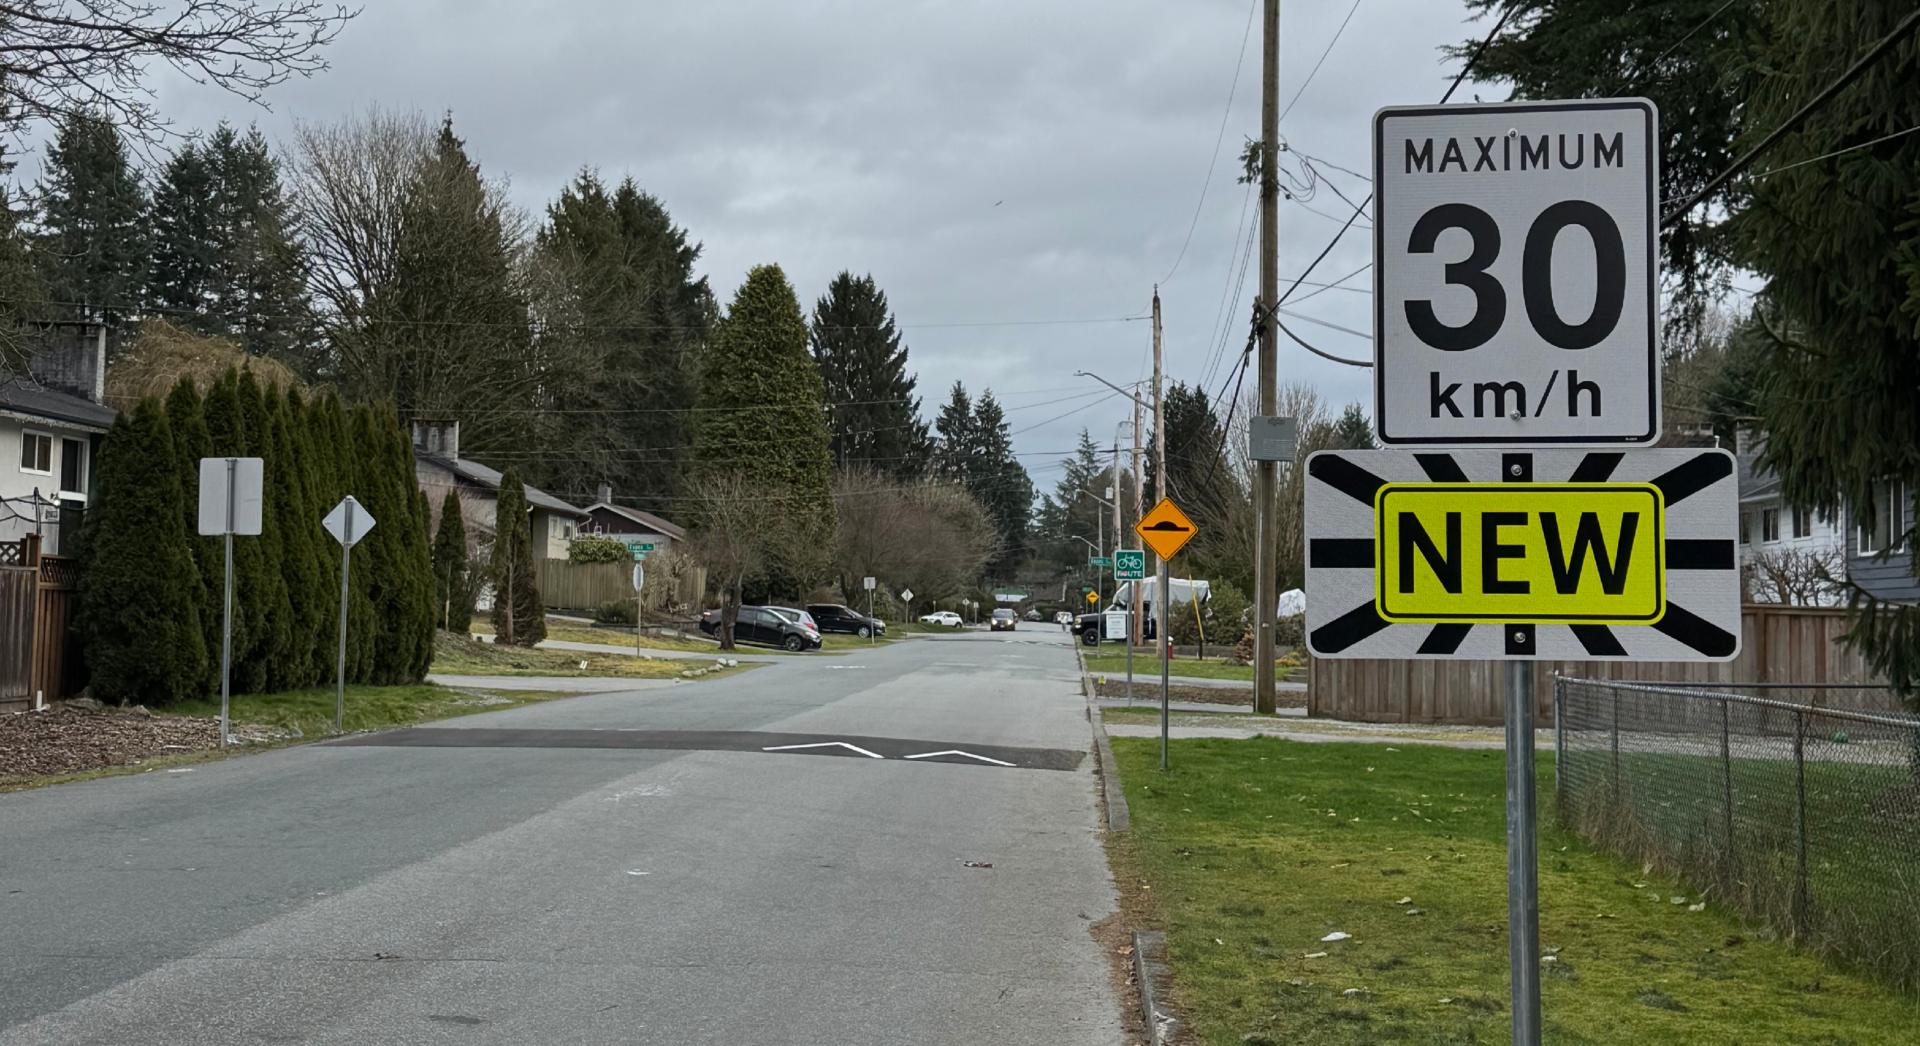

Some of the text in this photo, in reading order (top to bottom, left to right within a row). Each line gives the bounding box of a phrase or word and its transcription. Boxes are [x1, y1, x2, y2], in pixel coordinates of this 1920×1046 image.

[1405, 132, 1624, 174] MAXIMUM
[1403, 199, 1627, 352] 30
[1429, 370, 1602, 419] km/h
[1398, 511, 1640, 596] NEW
